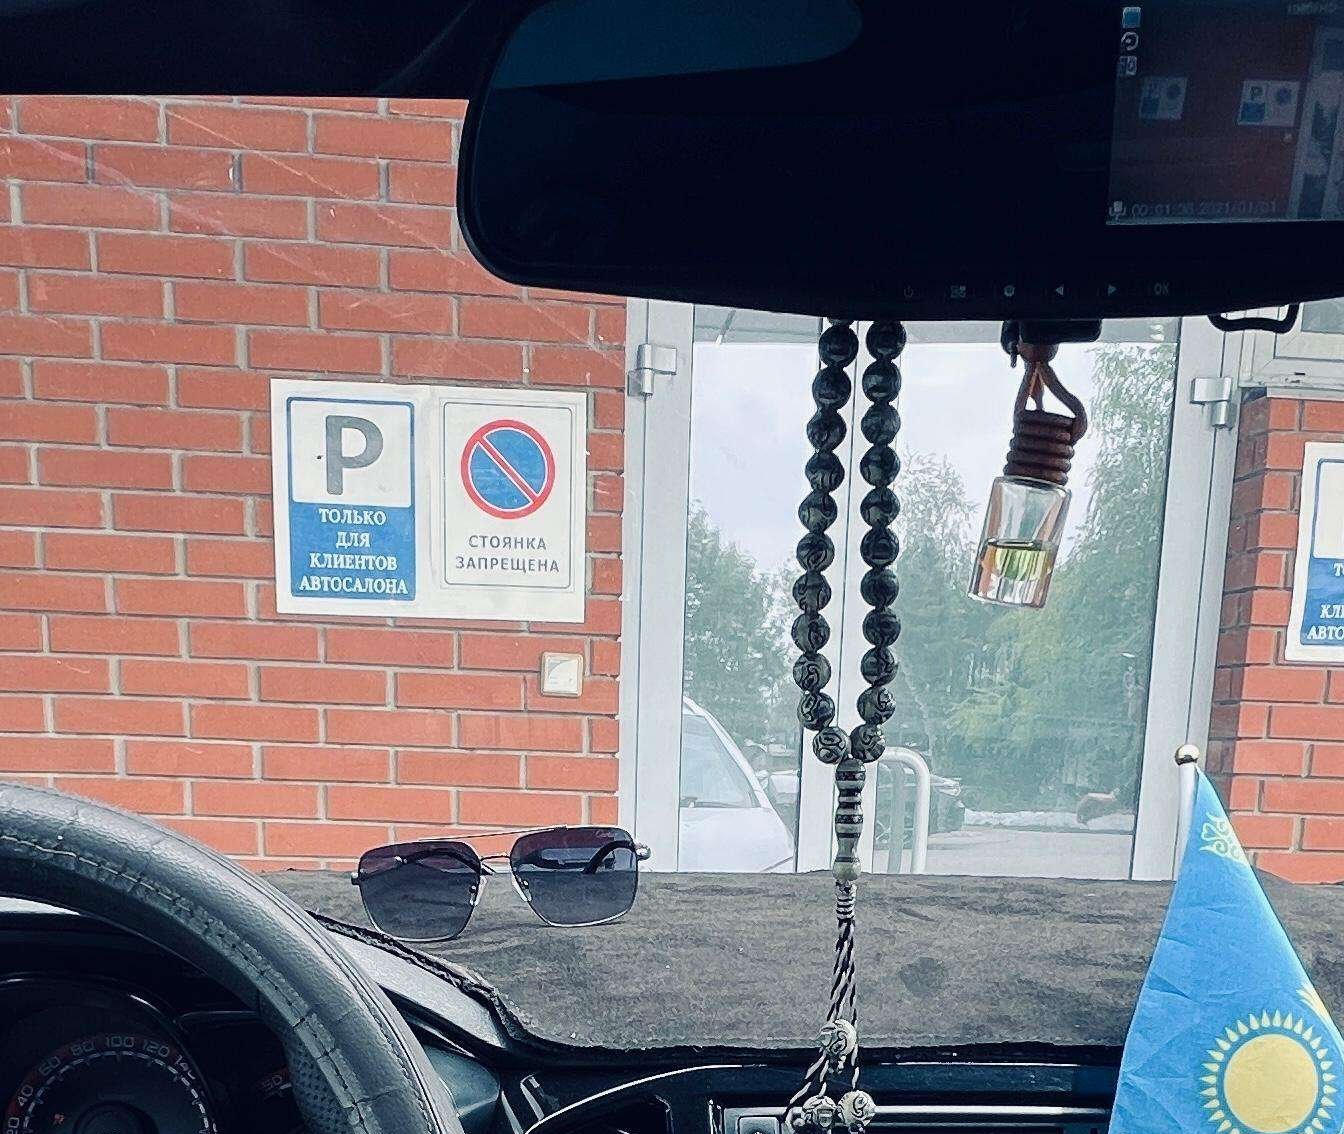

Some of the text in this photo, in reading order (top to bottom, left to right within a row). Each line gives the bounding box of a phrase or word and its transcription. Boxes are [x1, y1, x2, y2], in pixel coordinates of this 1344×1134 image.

[326, 415, 383, 495] P
[319, 509, 386, 526] ТОЛЬКО
[336, 532, 371, 548] ДЛЯ
[468, 535, 547, 550] СТОЯНКА
[309, 554, 397, 571] КЛИЕНТОВ
[455, 556, 560, 573] ЗАПРЕЩЕНА
[299, 577, 409, 595] АВТОСАЛОНА
[105, 1036, 135, 1047] 100
[143, 1041, 170, 1057] 120
[17, 1084, 34, 1106] 40
